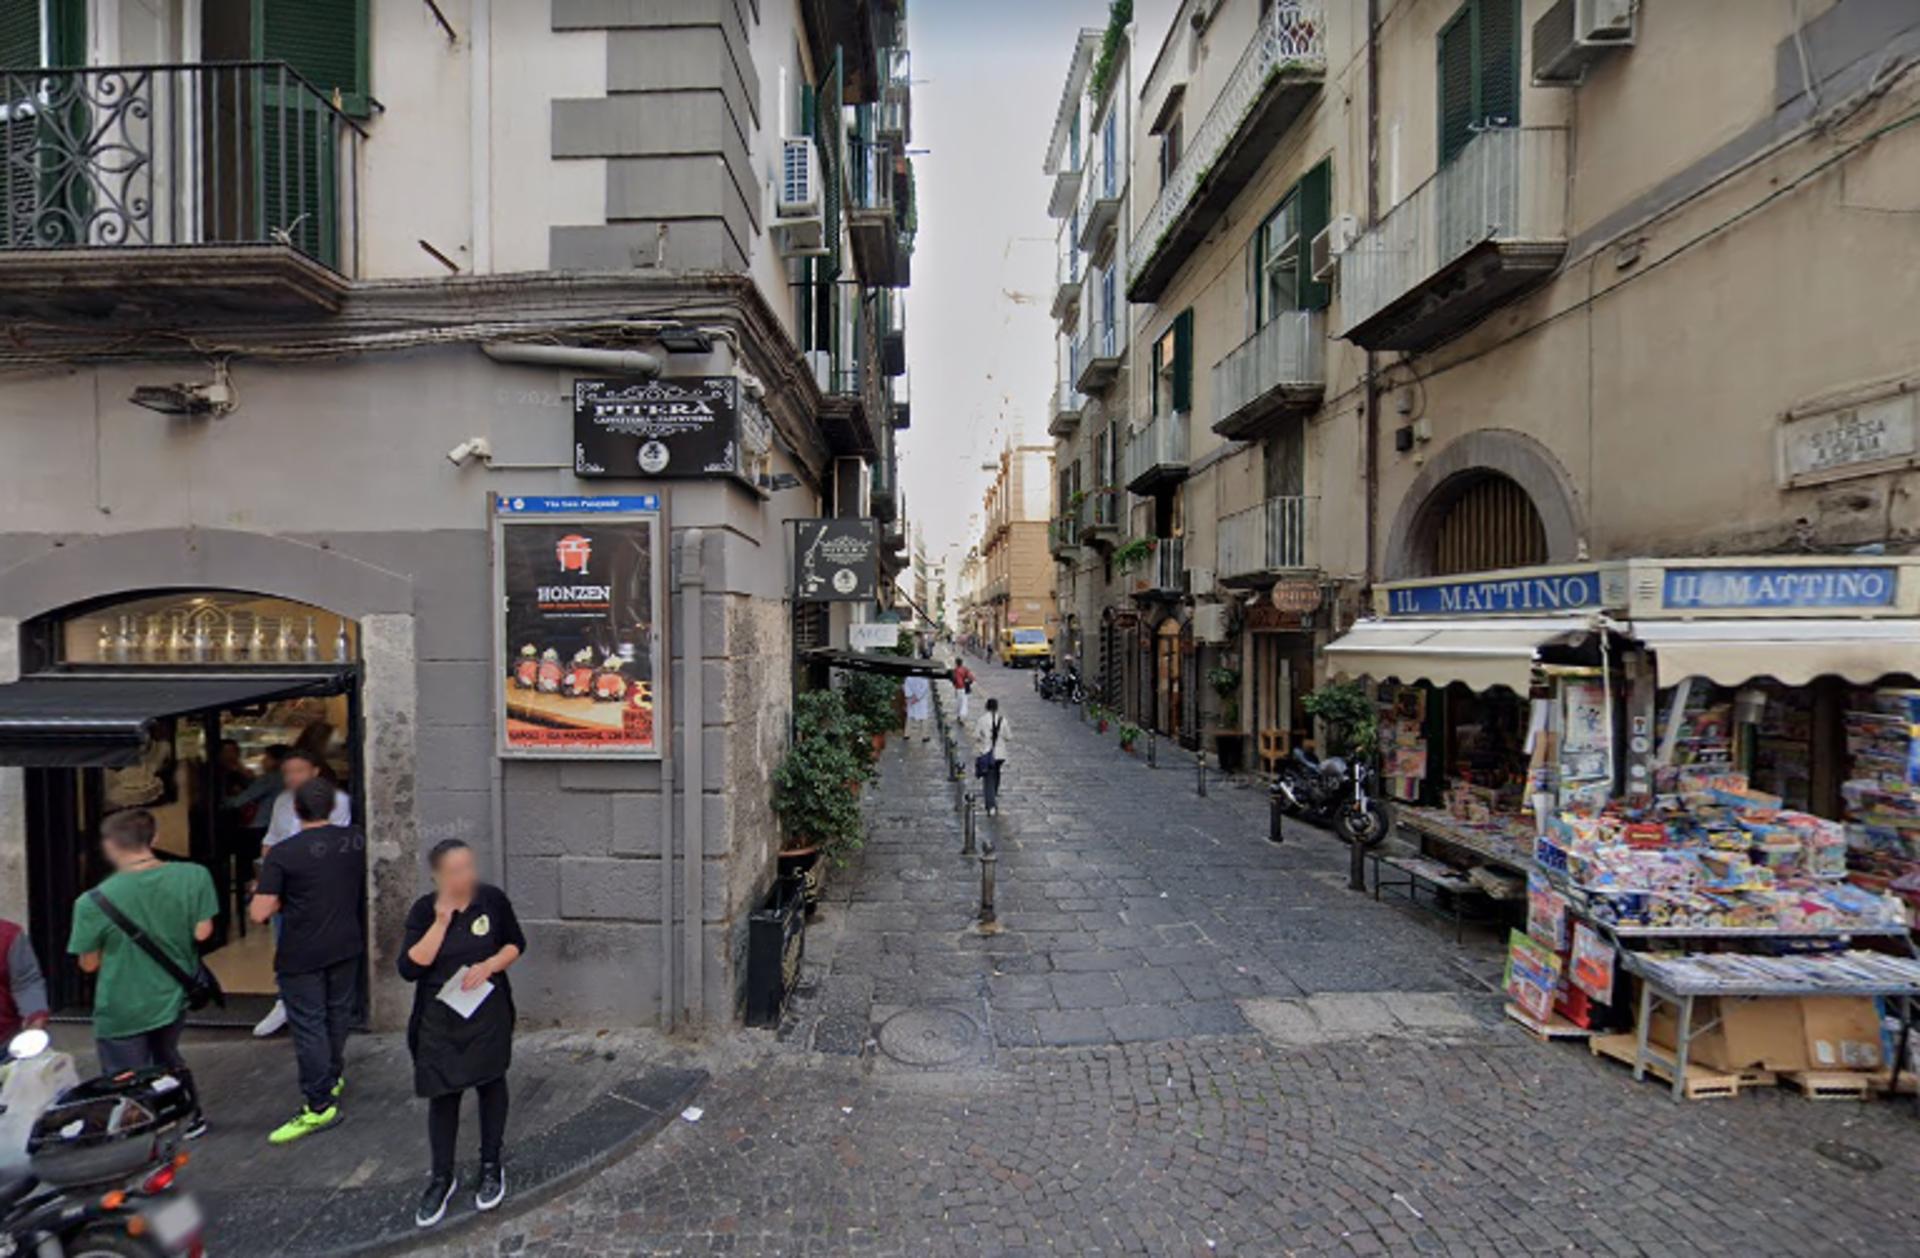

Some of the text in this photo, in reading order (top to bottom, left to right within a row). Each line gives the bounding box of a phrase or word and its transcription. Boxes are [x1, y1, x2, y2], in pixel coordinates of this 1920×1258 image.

[594, 400, 715, 416] PITERÀ
[537, 586, 610, 601] HONZEN
[1398, 577, 1588, 612] IL MATTINO
[1672, 573, 1884, 602] IL MATTINO
